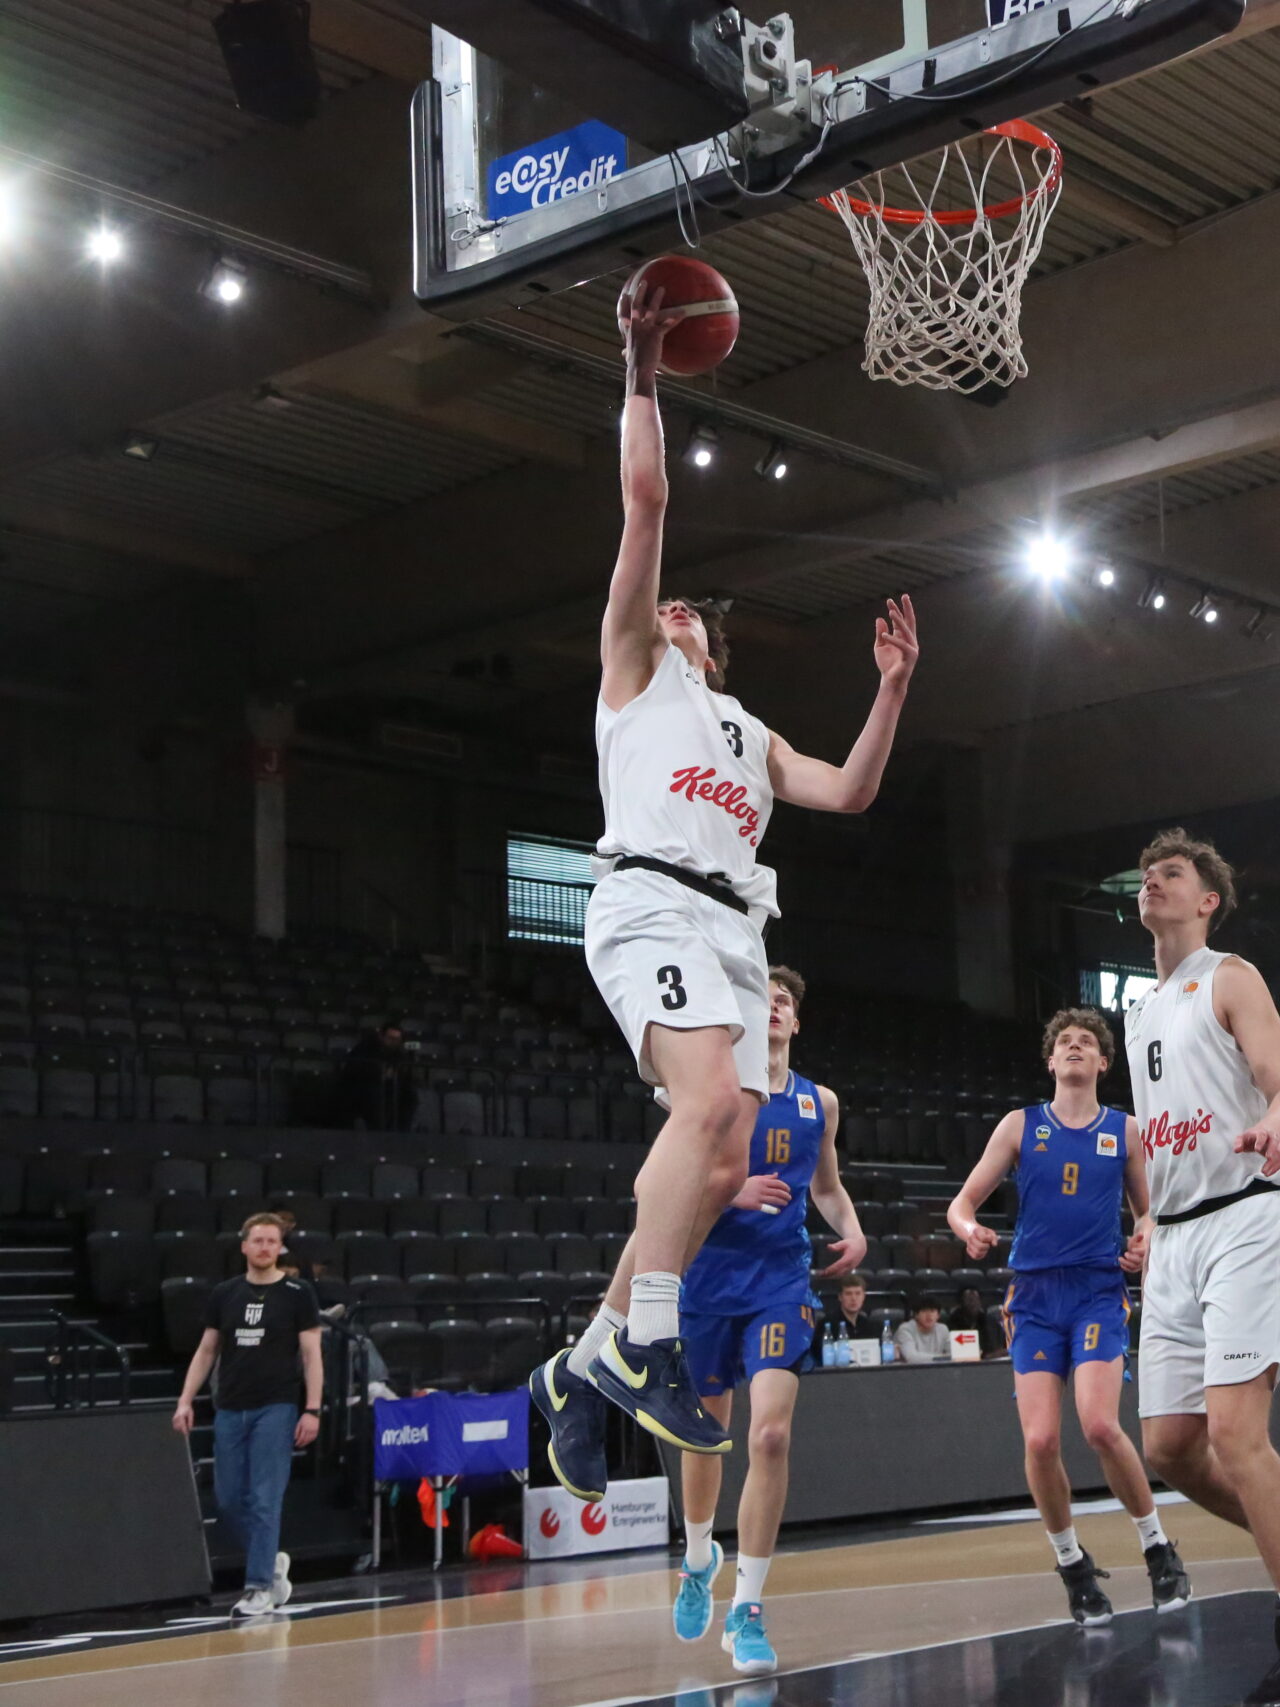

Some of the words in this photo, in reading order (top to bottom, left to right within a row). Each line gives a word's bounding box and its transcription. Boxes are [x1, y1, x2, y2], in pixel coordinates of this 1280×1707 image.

[531, 154, 617, 209] Credit
[721, 720, 744, 758] 3
[657, 964, 688, 1011] 3
[1147, 1039, 1163, 1082] 6
[765, 1128, 791, 1164] 16
[1061, 1162, 1080, 1196] 9
[759, 1322, 786, 1360] 16
[1083, 1323, 1101, 1351] 9
[1223, 1352, 1252, 1361] CRAFT
